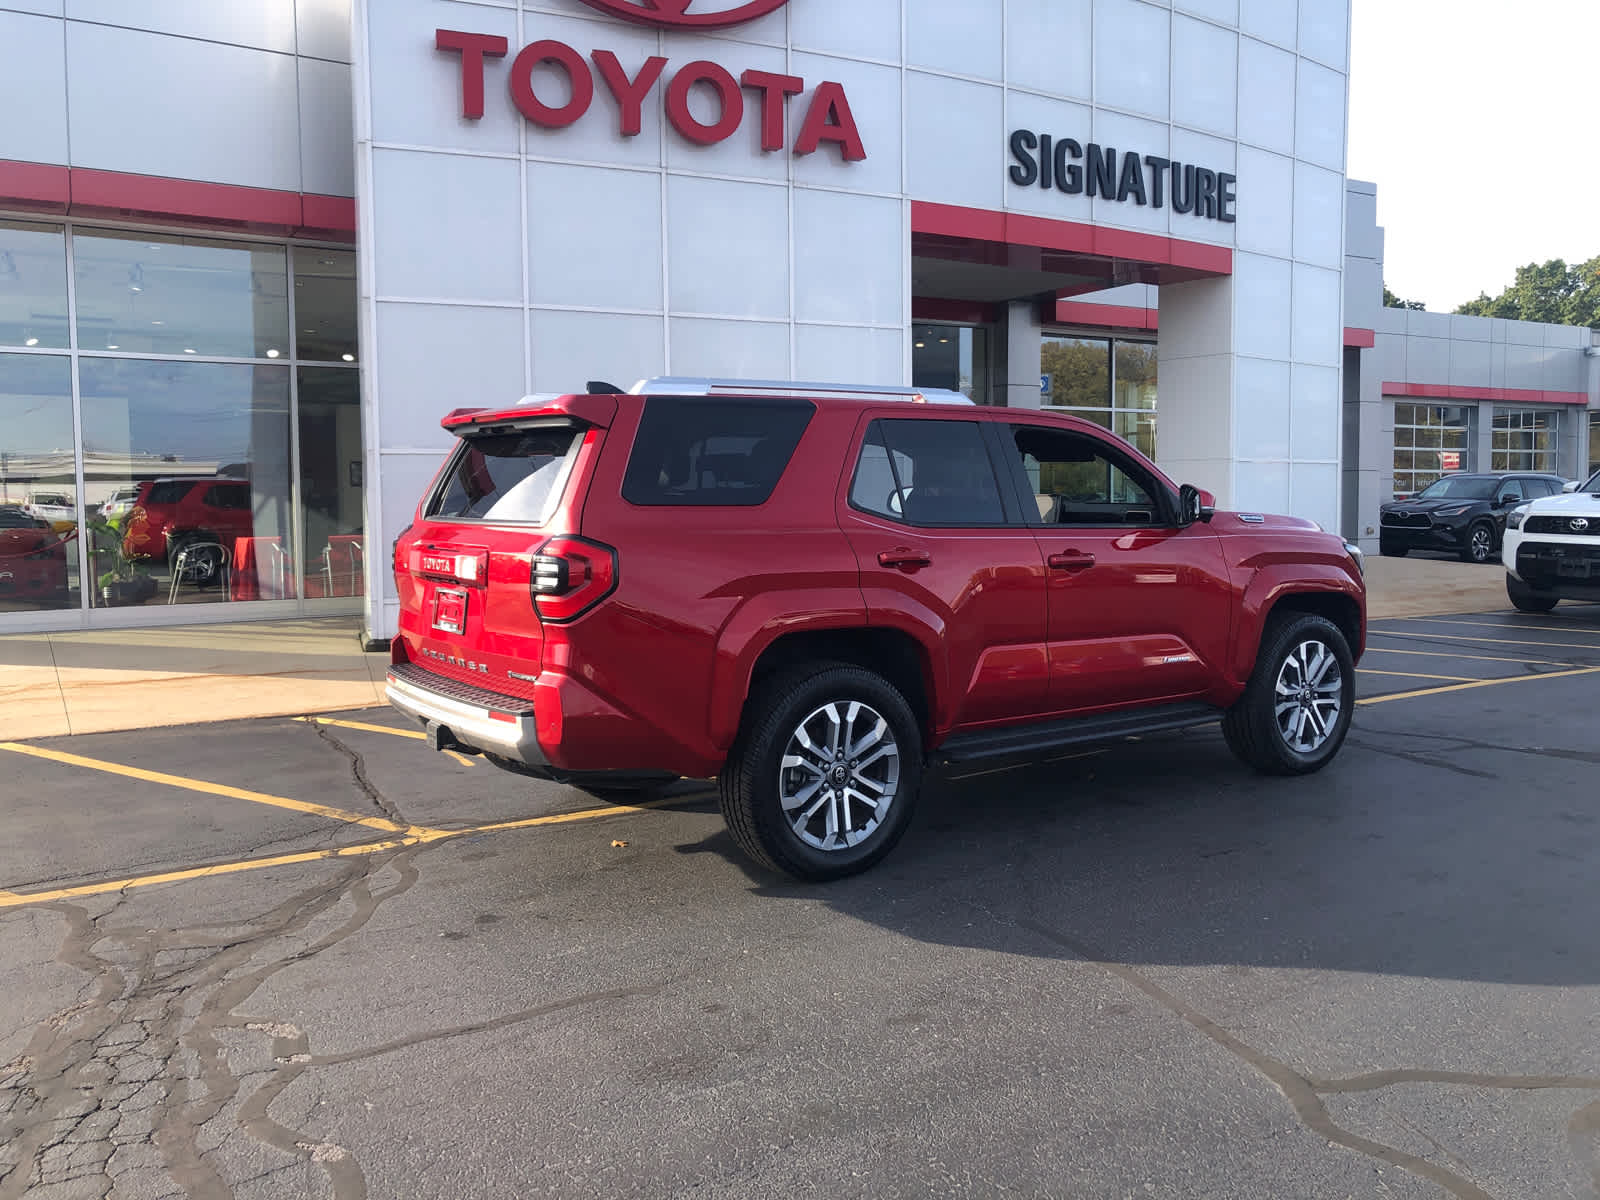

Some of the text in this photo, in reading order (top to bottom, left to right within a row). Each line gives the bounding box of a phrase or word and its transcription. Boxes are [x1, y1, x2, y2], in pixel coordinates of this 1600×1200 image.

[435, 29, 866, 161] TOYOTA
[1010, 129, 1236, 222] SIGNATURE
[423, 558, 450, 571] TOYOTA
